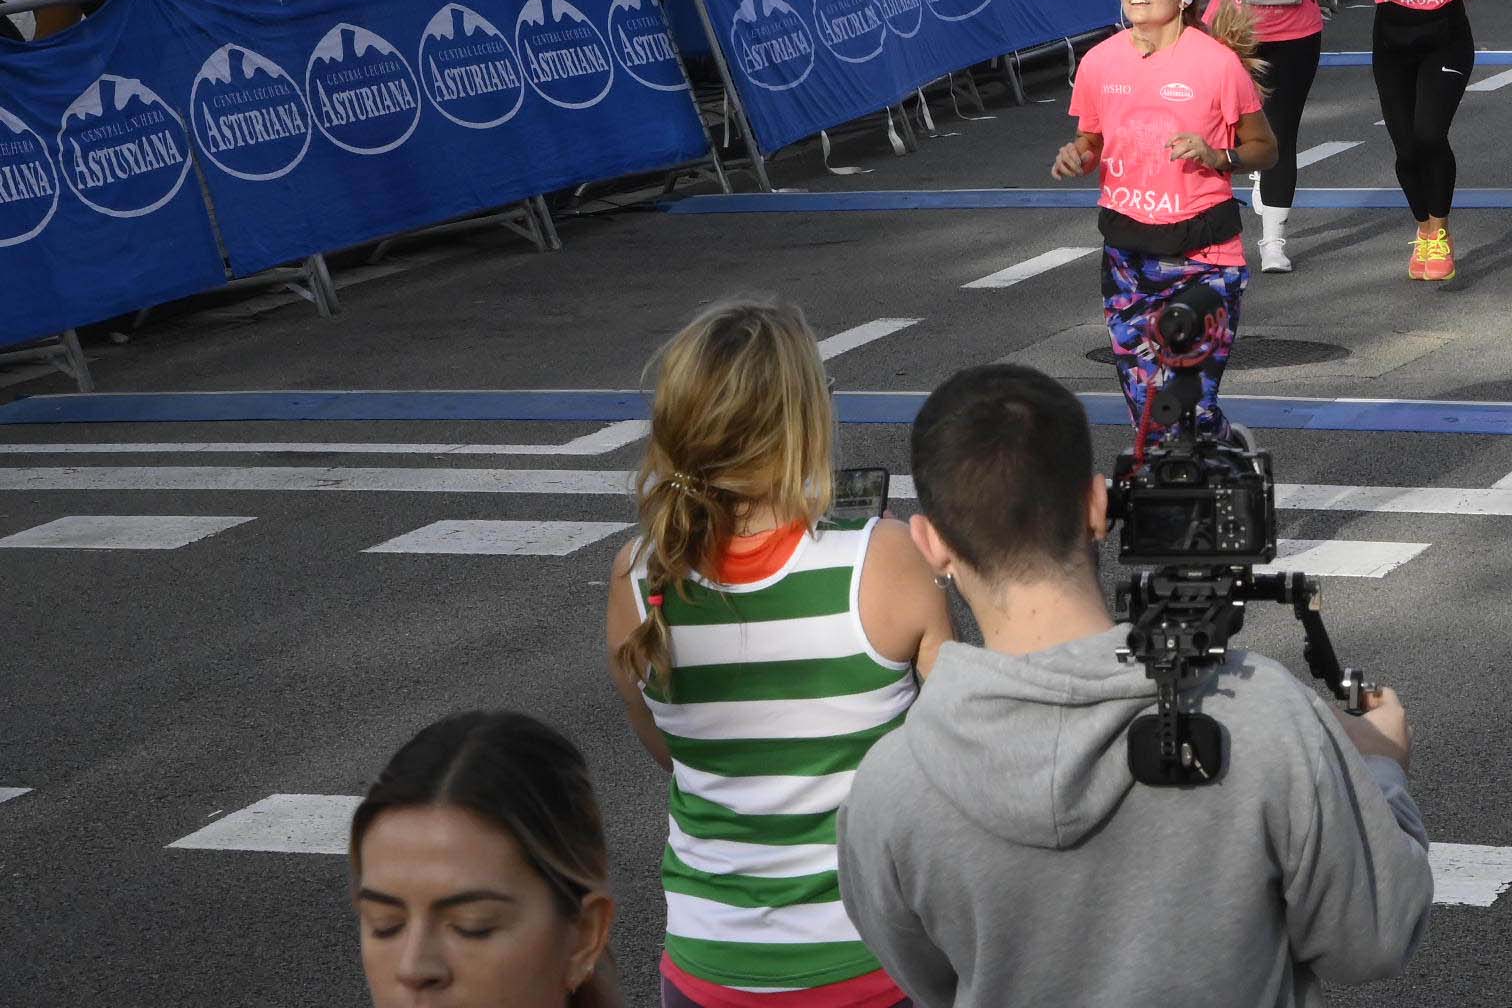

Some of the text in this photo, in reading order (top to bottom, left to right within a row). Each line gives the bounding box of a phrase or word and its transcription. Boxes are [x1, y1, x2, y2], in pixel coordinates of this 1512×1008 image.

[428, 54, 520, 102] ASTURIANA
[524, 39, 609, 84] ASTURIANA
[202, 101, 307, 153] ASTURIANA
[316, 78, 416, 128] ASTURIANA
